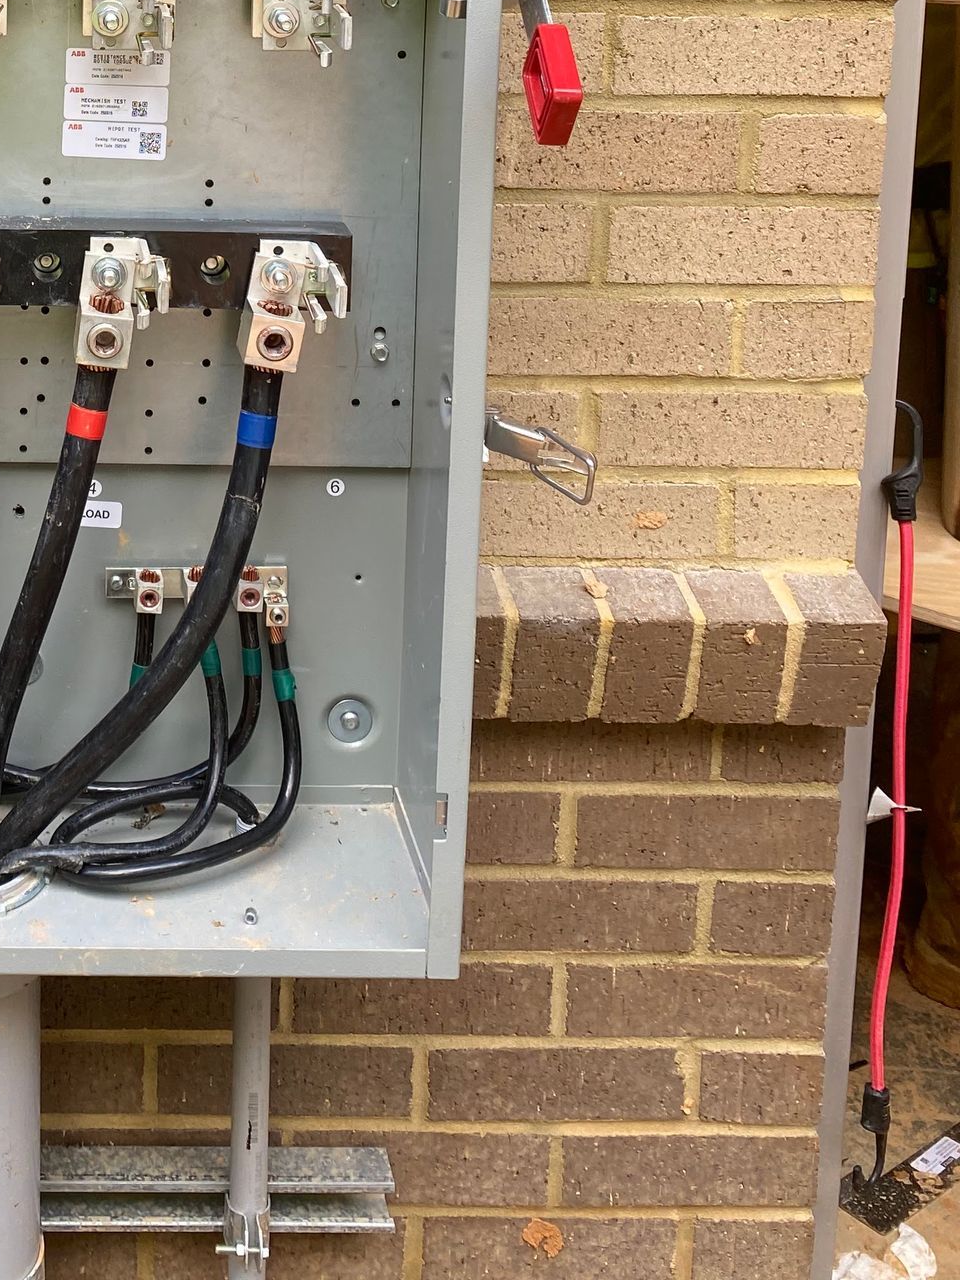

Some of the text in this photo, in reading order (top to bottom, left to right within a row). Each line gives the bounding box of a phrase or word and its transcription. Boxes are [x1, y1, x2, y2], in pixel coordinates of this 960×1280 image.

[89, 482, 97, 495] 4
[331, 480, 340, 494] 6
[82, 509, 111, 519] OAD
